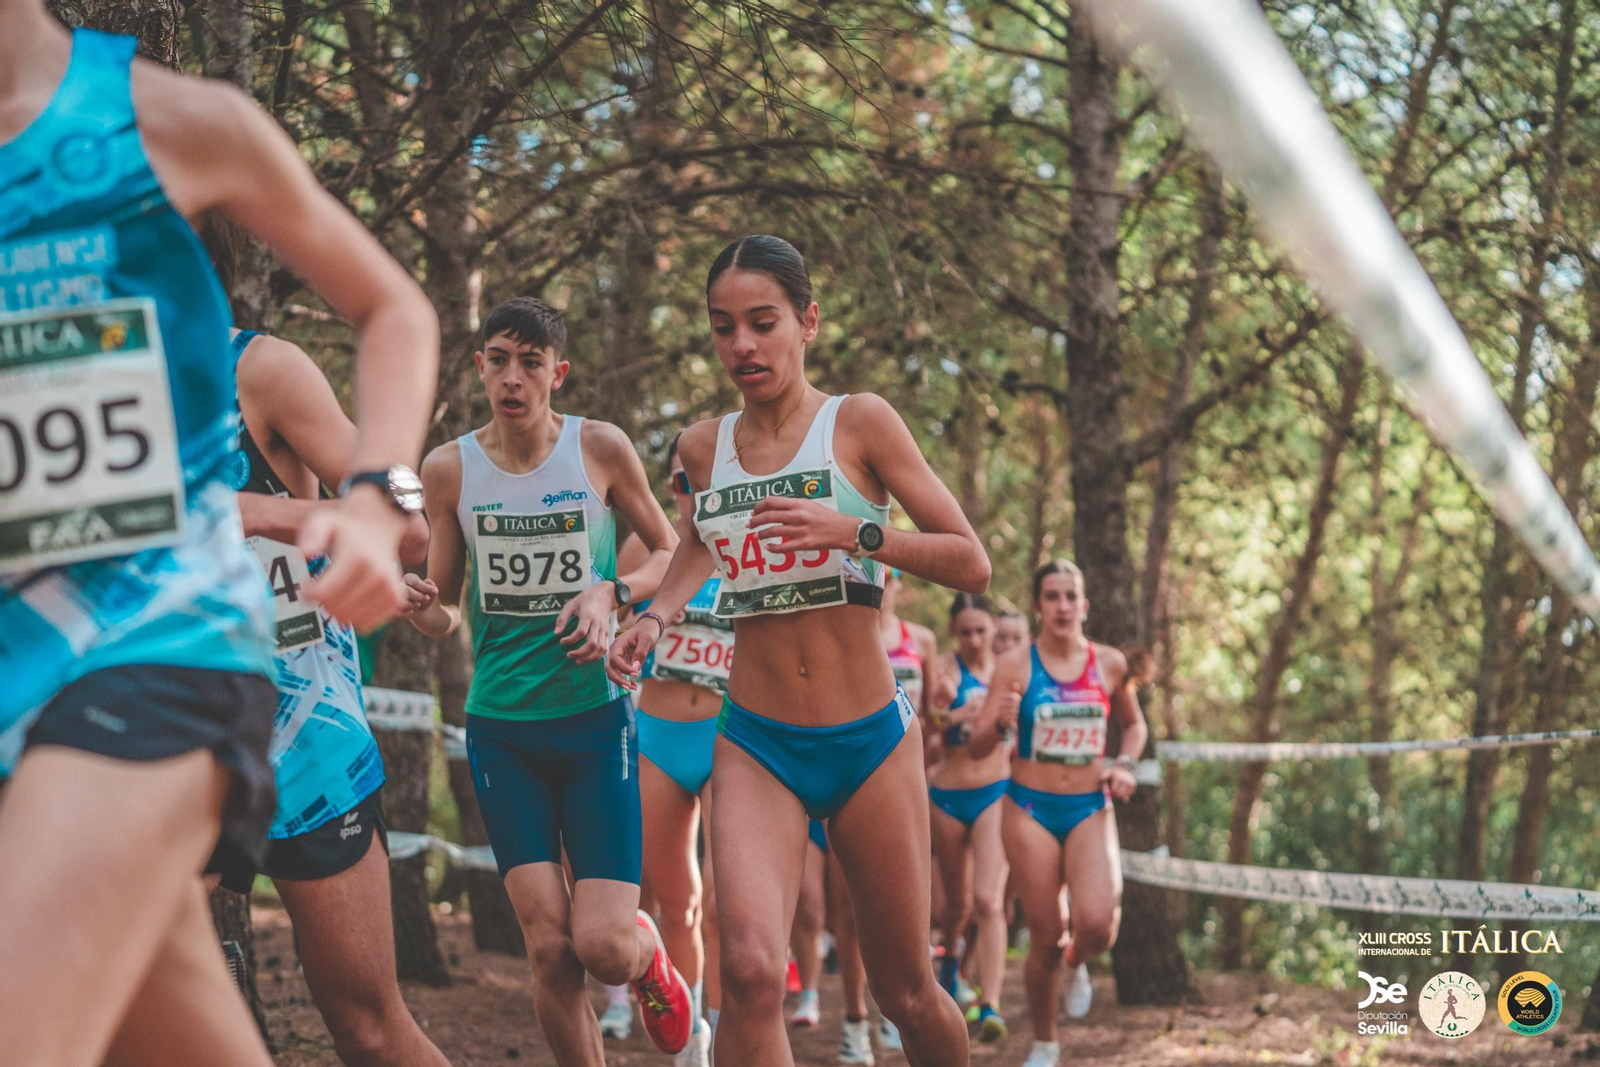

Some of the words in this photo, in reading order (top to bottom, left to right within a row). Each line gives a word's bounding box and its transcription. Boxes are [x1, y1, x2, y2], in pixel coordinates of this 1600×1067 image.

[729, 479, 795, 504] ITÁLICA
[472, 502, 503, 512] FASTER
[504, 516, 557, 530] ITÁLICA
[488, 549, 583, 587] 5978
[528, 598, 562, 610] FAA
[763, 590, 806, 607] FAA
[1041, 728, 1099, 749] 7474
